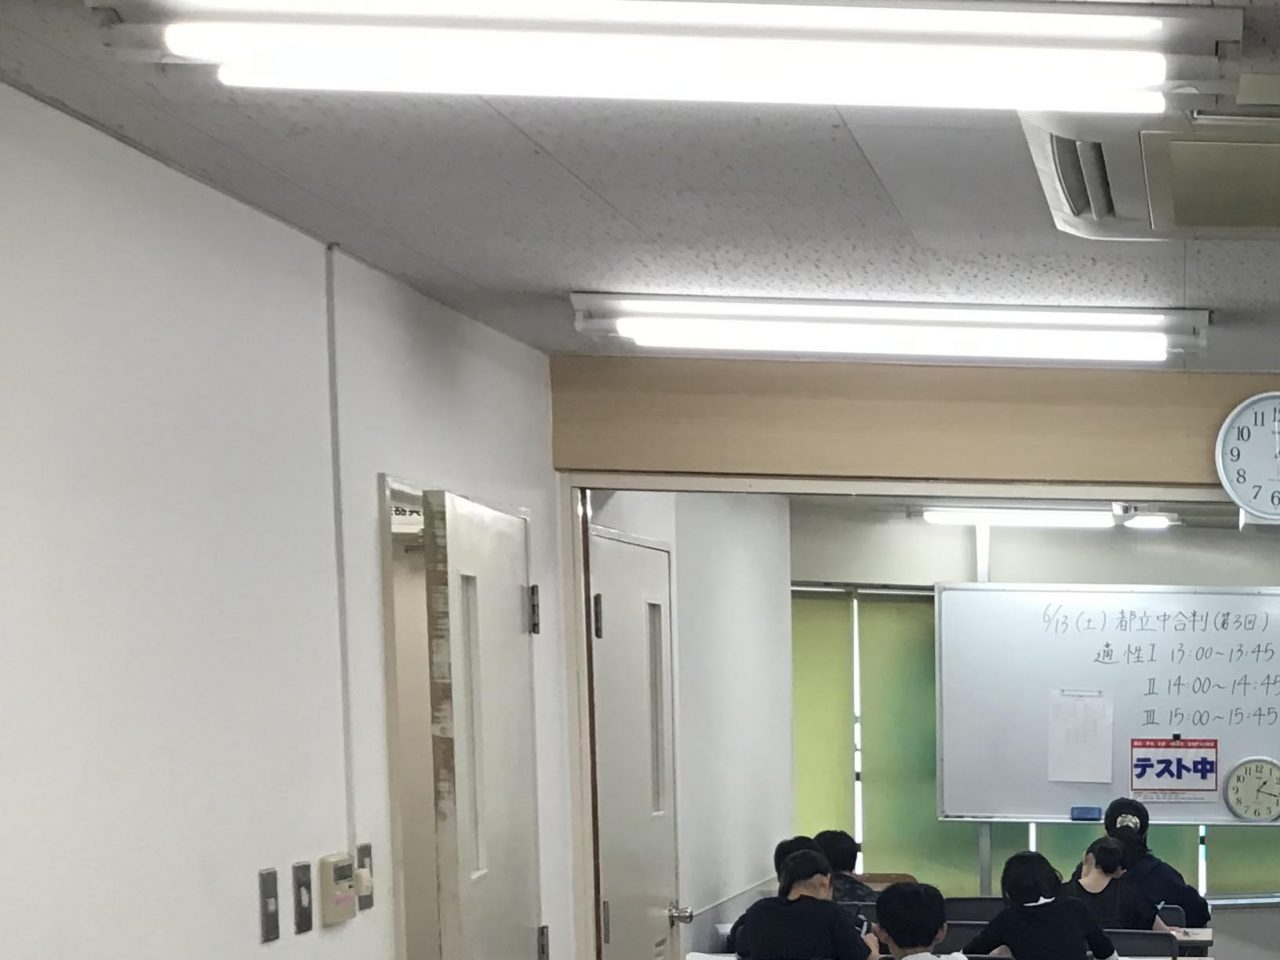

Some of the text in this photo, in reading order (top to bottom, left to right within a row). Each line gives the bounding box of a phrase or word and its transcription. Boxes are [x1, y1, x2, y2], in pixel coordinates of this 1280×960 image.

[1253, 410, 1265, 427] 11
[1236, 425, 1251, 442] 10
[1230, 447, 1241, 462] 9
[1236, 468, 1247, 484] 8
[1252, 484, 1262, 500] 7
[1133, 756, 1215, 780] テスト中
[1244, 766, 1252, 776] 11
[1255, 764, 1264, 773] 12
[1236, 774, 1245, 783] 10
[1253, 808, 1261, 817] 6
